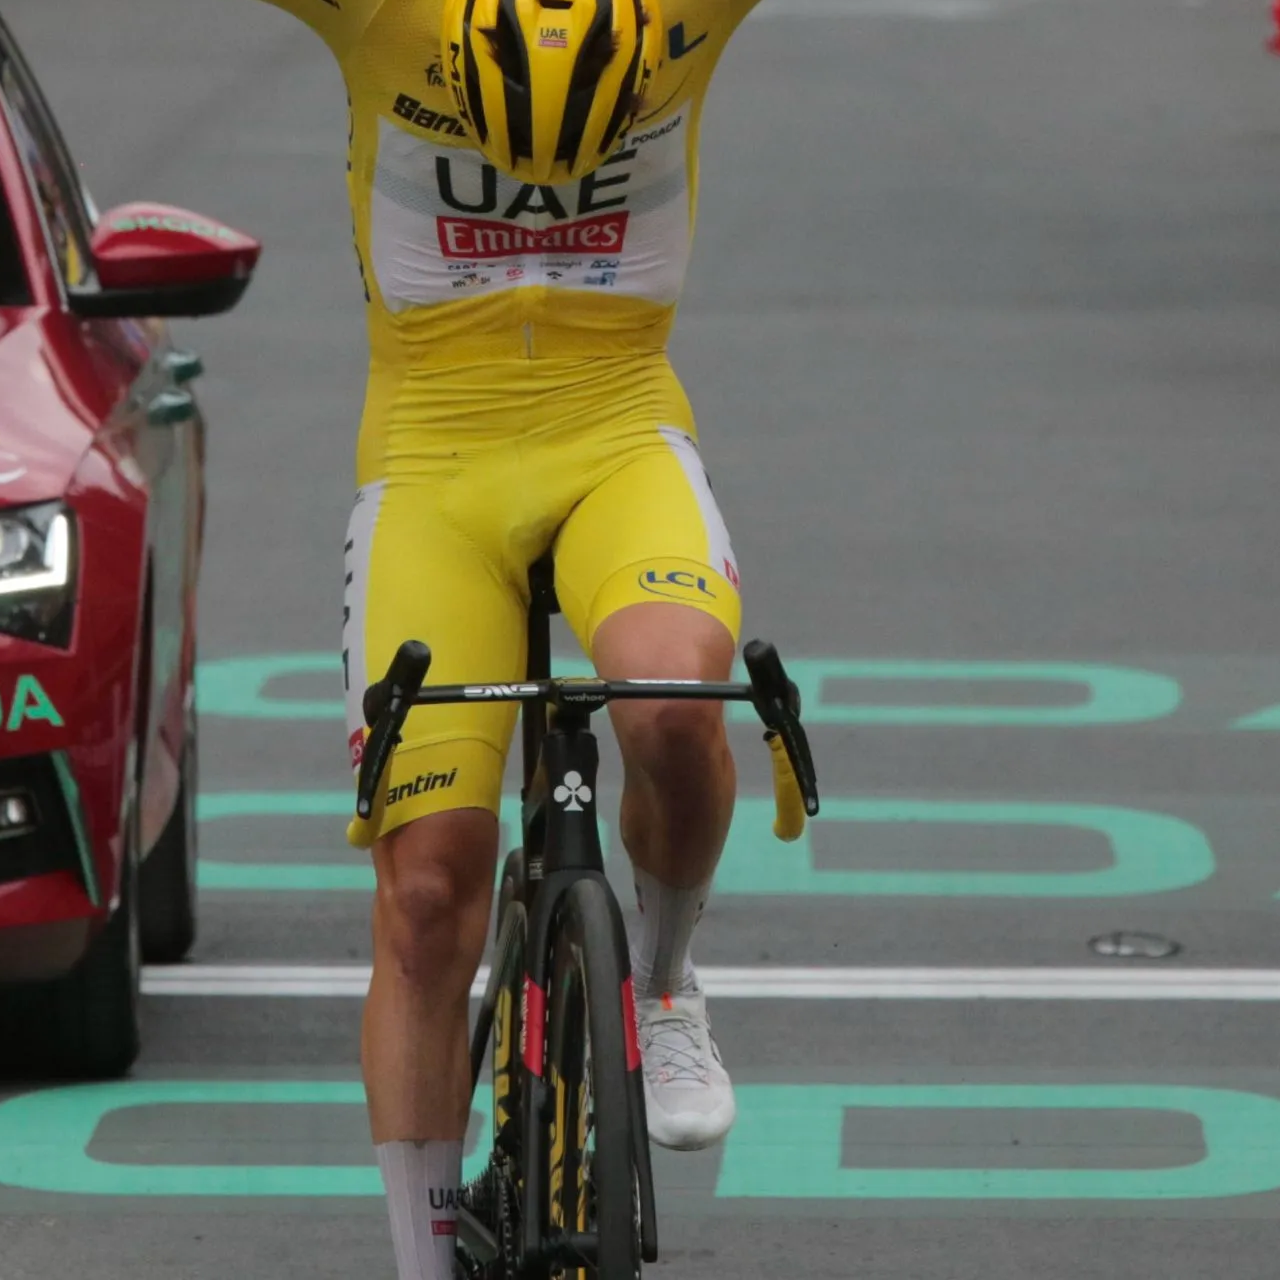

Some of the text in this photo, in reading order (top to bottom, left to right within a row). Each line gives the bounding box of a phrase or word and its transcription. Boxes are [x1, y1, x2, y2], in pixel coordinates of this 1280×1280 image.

[539, 27, 567, 39] UAE
[435, 148, 637, 221] UAE
[646, 570, 717, 599] LCL
